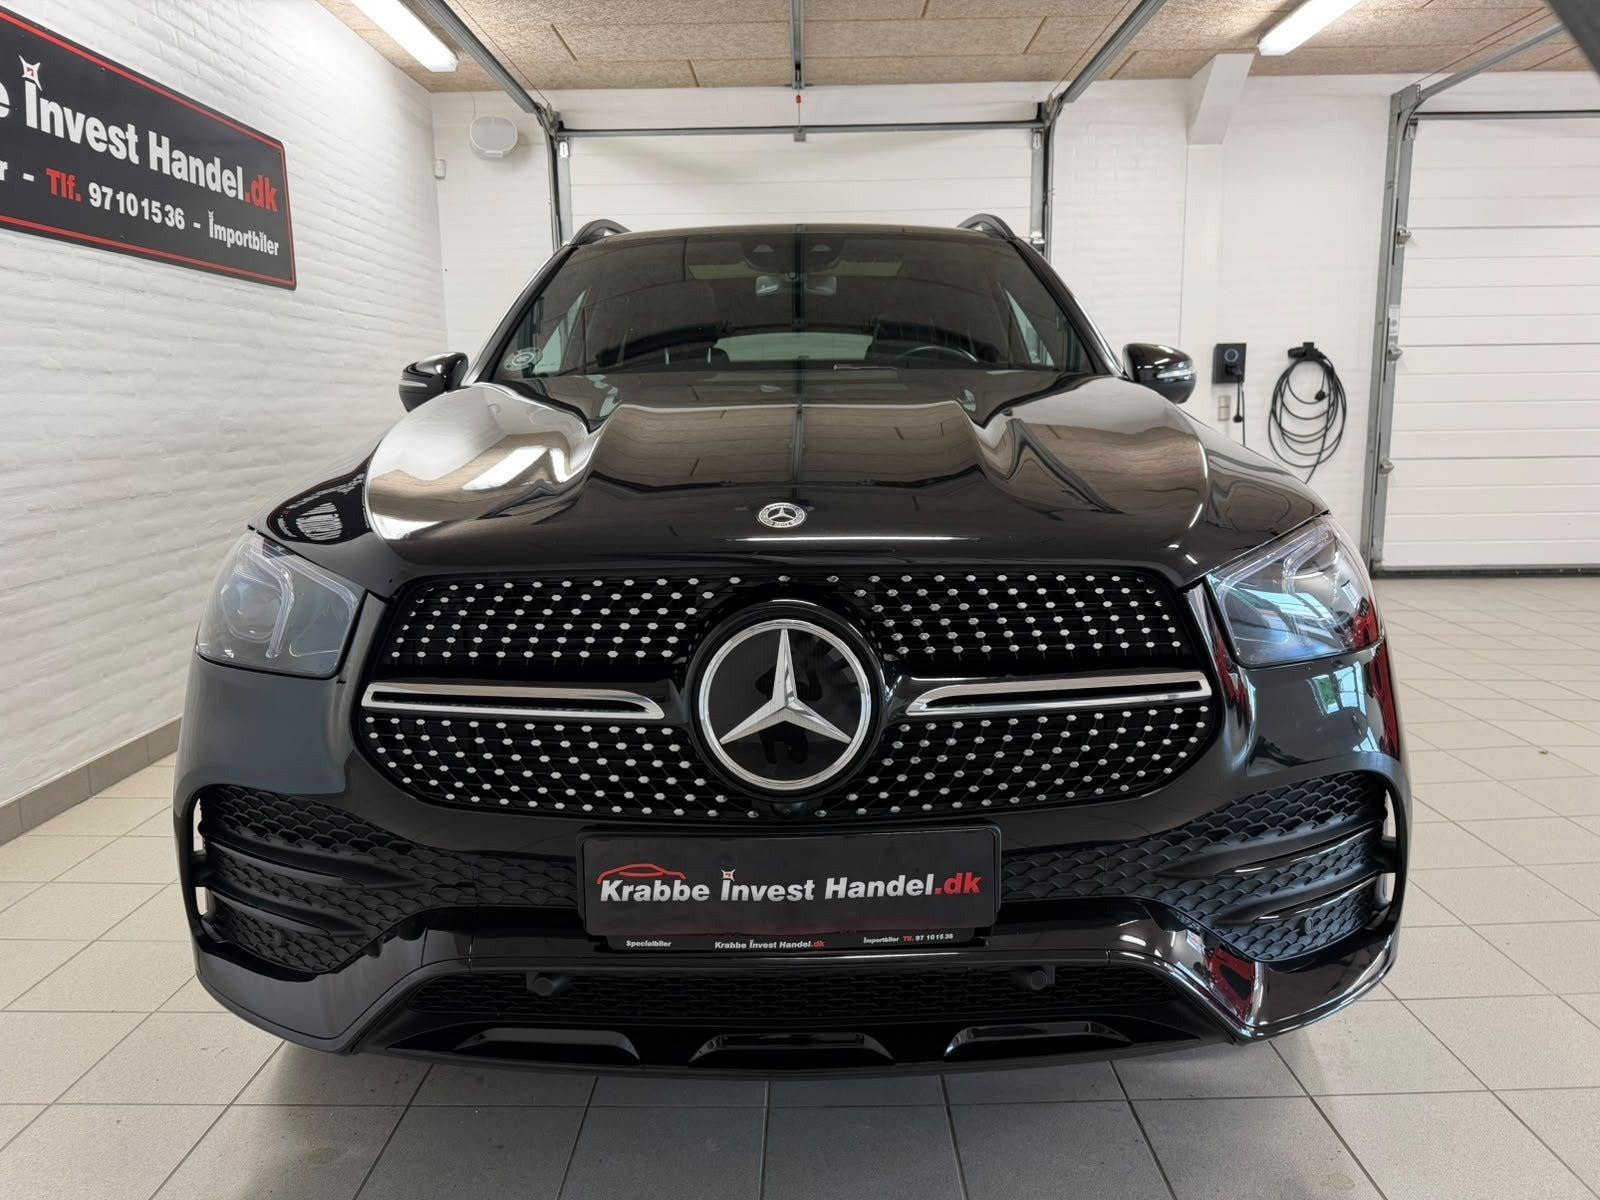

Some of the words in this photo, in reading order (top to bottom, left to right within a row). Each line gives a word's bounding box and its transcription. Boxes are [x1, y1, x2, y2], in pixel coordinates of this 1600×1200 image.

[149, 130, 278, 212] Handel.dk
[46, 168, 82, 203] Tlf.
[208, 210, 279, 256] Importbiler
[600, 879, 710, 902] Krabbe
[824, 872, 982, 900] Handel.dk
[626, 940, 672, 948] Specialbiler
[714, 941, 747, 949] Krabbe
[779, 940, 825, 949] Handel.dk
[863, 936, 900, 945] Importbiler
